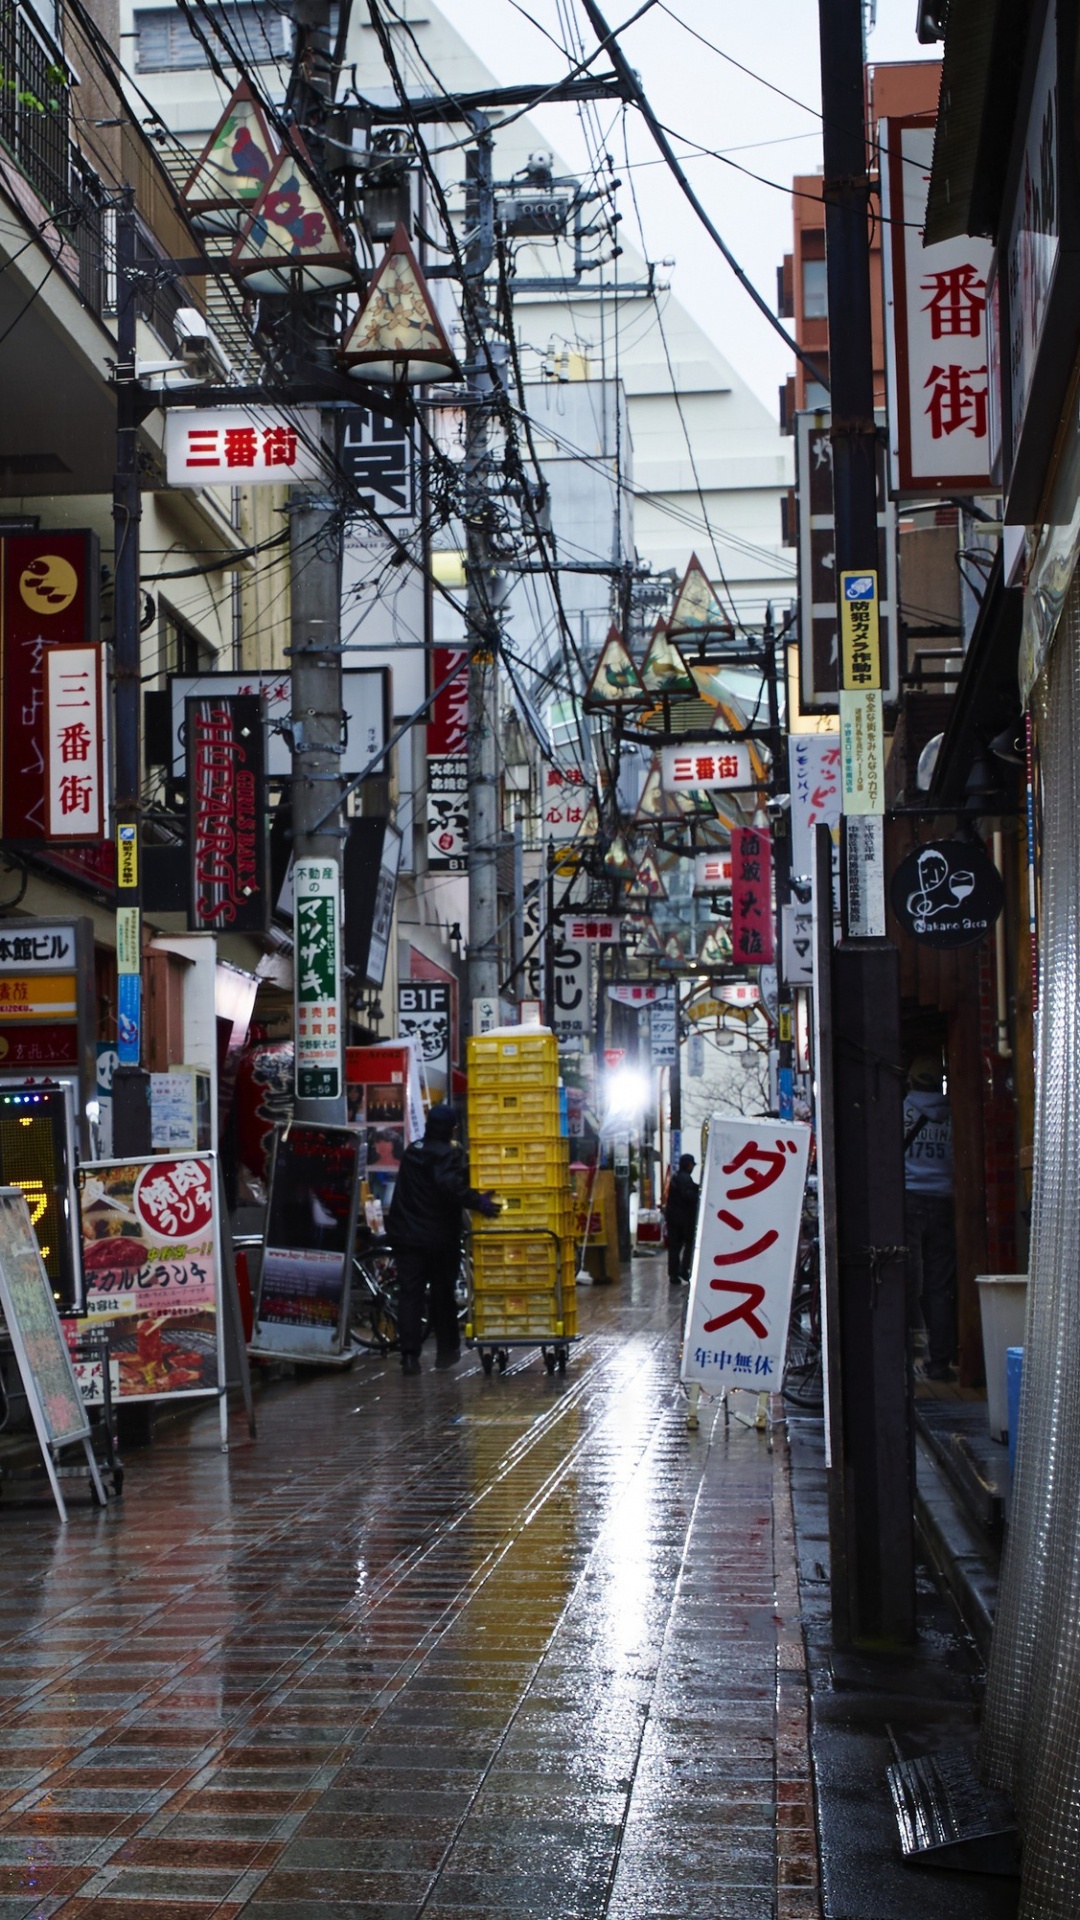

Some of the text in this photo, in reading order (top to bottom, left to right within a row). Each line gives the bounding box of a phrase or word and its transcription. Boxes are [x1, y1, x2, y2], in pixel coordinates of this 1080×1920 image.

[919, 176, 988, 439] 番街
[185, 427, 299, 467] 三番街
[850, 602, 872, 684] 防犯カメラ作動中
[56, 672, 94, 815] 三番街
[673, 755, 739, 781] 三番街
[196, 709, 247, 922] HEARTS
[236, 770, 256, 876] GIRLS BAR
[297, 867, 334, 880] 不動産
[308, 882, 320, 893] の
[298, 898, 329, 995] マツザキ
[572, 923, 613, 938] 三番街
[400, 988, 446, 1011] B1F
[617, 987, 657, 999] 三番街
[721, 987, 760, 999] 三番街
[908, 1141, 945, 1159] 1755
[140, 1162, 207, 1216] 焼肉
[157, 1186, 211, 1235] ランチ
[704, 1139, 797, 1339] ダンス
[694, 1347, 775, 1375] 年中無休
